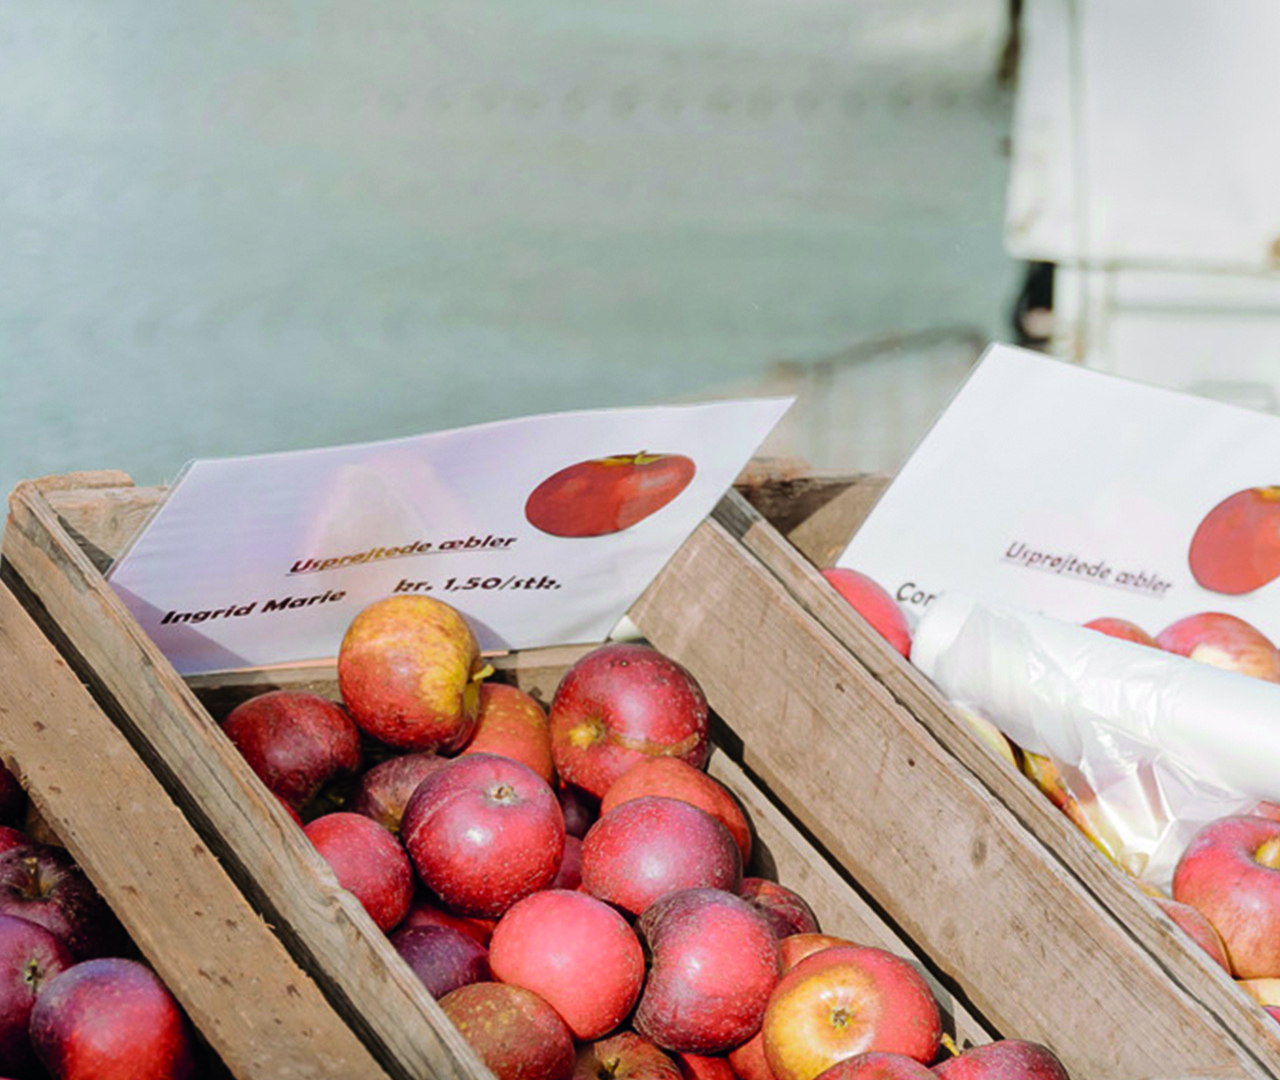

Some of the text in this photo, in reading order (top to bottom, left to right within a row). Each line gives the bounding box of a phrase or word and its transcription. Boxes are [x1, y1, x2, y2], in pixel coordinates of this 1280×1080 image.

[289, 534, 518, 574] Usprøjtede æbler
[1005, 541, 1173, 594] Usprøjtede æbler
[161, 575, 563, 626] Ingrid Marie kr. 1,50/stk.
[896, 582, 940, 607] Cor
